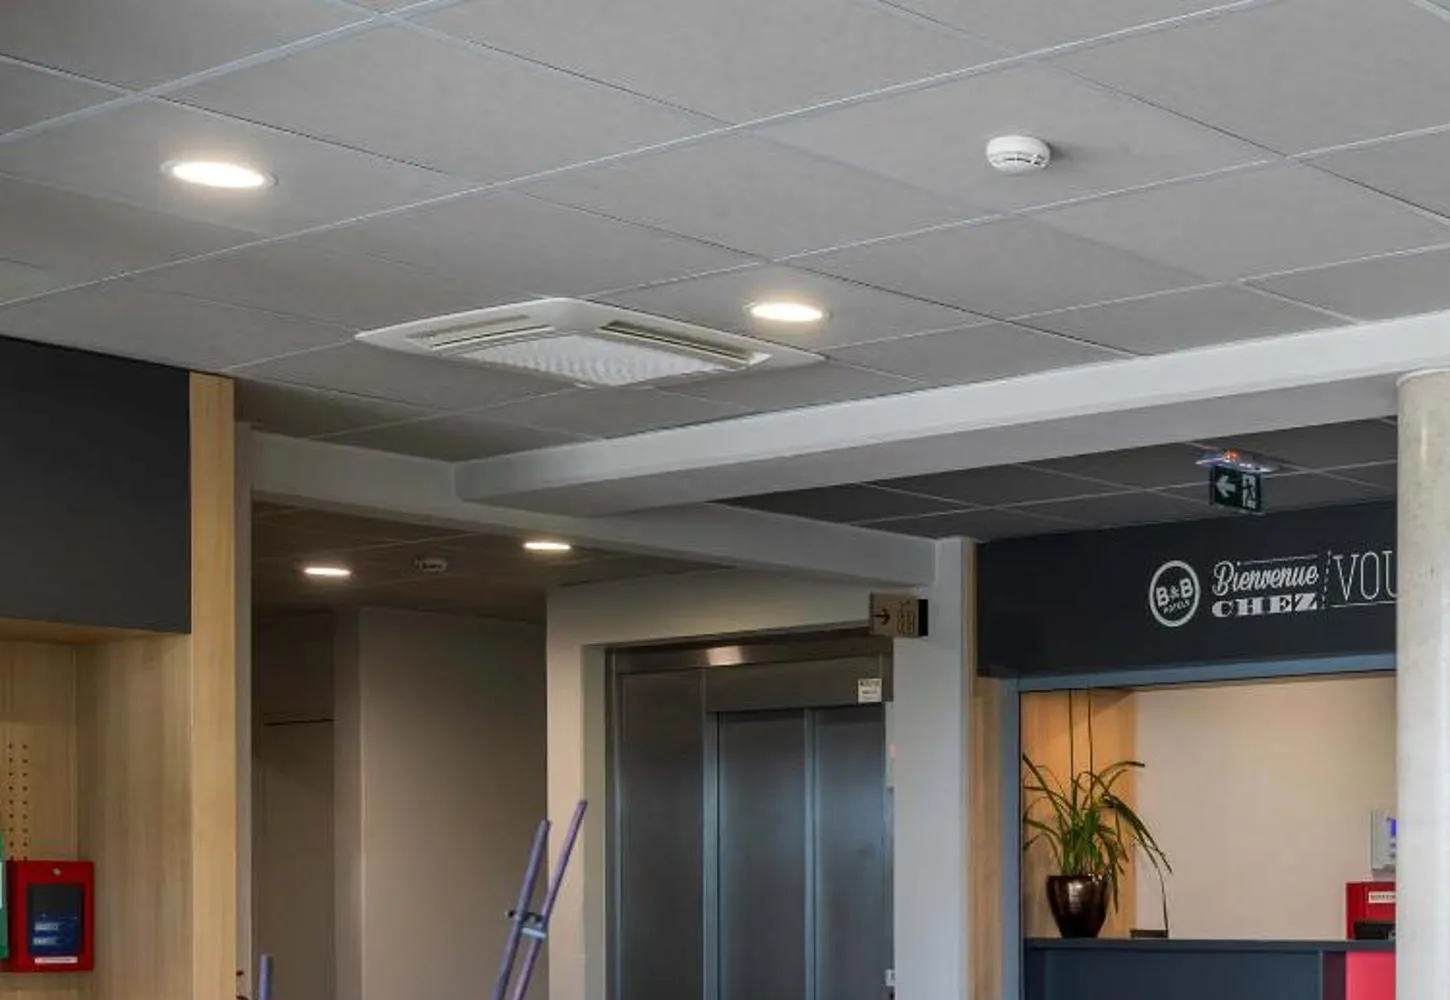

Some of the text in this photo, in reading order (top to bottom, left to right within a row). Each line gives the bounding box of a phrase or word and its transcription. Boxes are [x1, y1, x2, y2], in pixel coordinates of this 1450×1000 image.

[1155, 578, 1193, 607] B&B
[1212, 561, 1319, 596] Bienvenue
[1212, 593, 1318, 617] CHEZ
